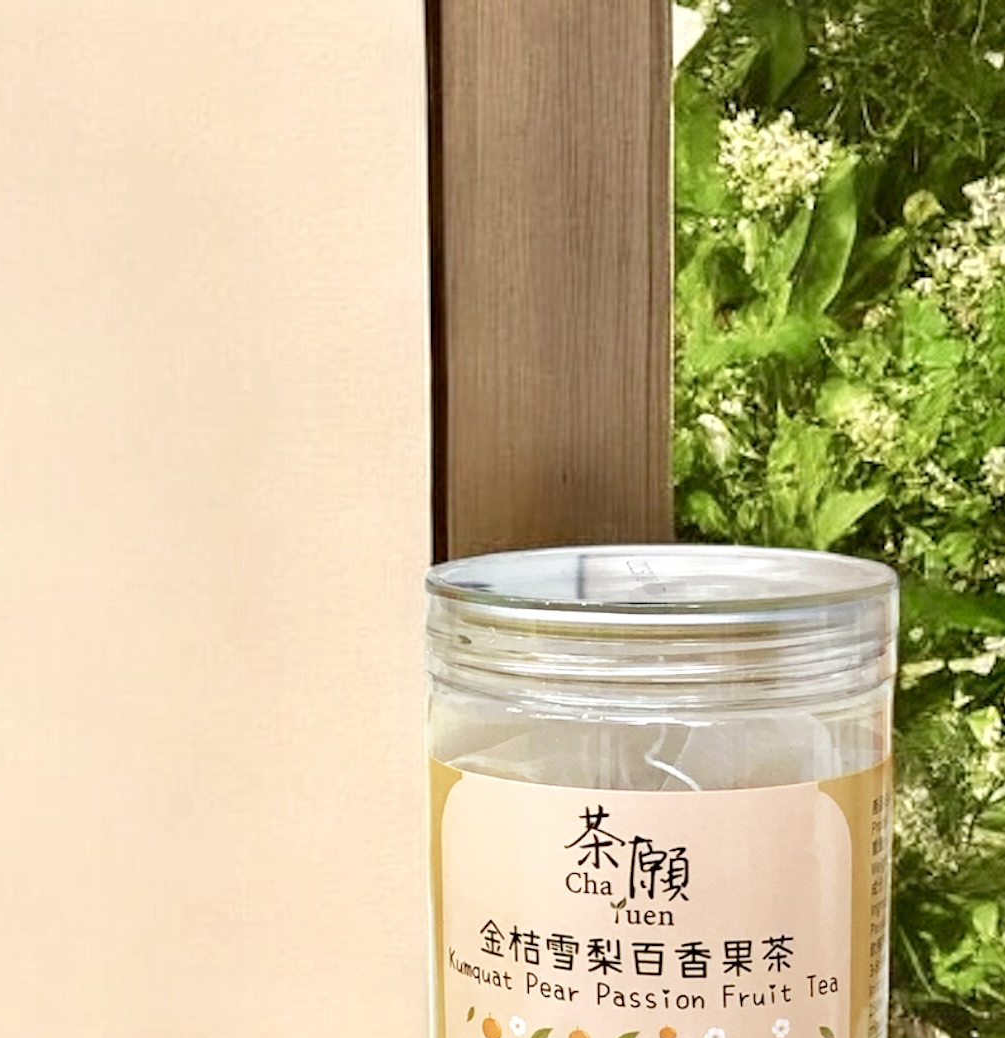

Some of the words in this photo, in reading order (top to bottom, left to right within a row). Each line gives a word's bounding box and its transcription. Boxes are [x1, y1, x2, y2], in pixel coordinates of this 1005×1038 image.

[565, 872, 613, 896] Cha
[609, 897, 675, 926] Yuen
[479, 919, 795, 979] 金桔雪梨百香果茶
[448, 946, 513, 991] Kumquat
[526, 971, 580, 1003] Pear
[596, 981, 706, 1010] Passion
[722, 983, 793, 1009] Fruit
[806, 974, 839, 998] Tea
